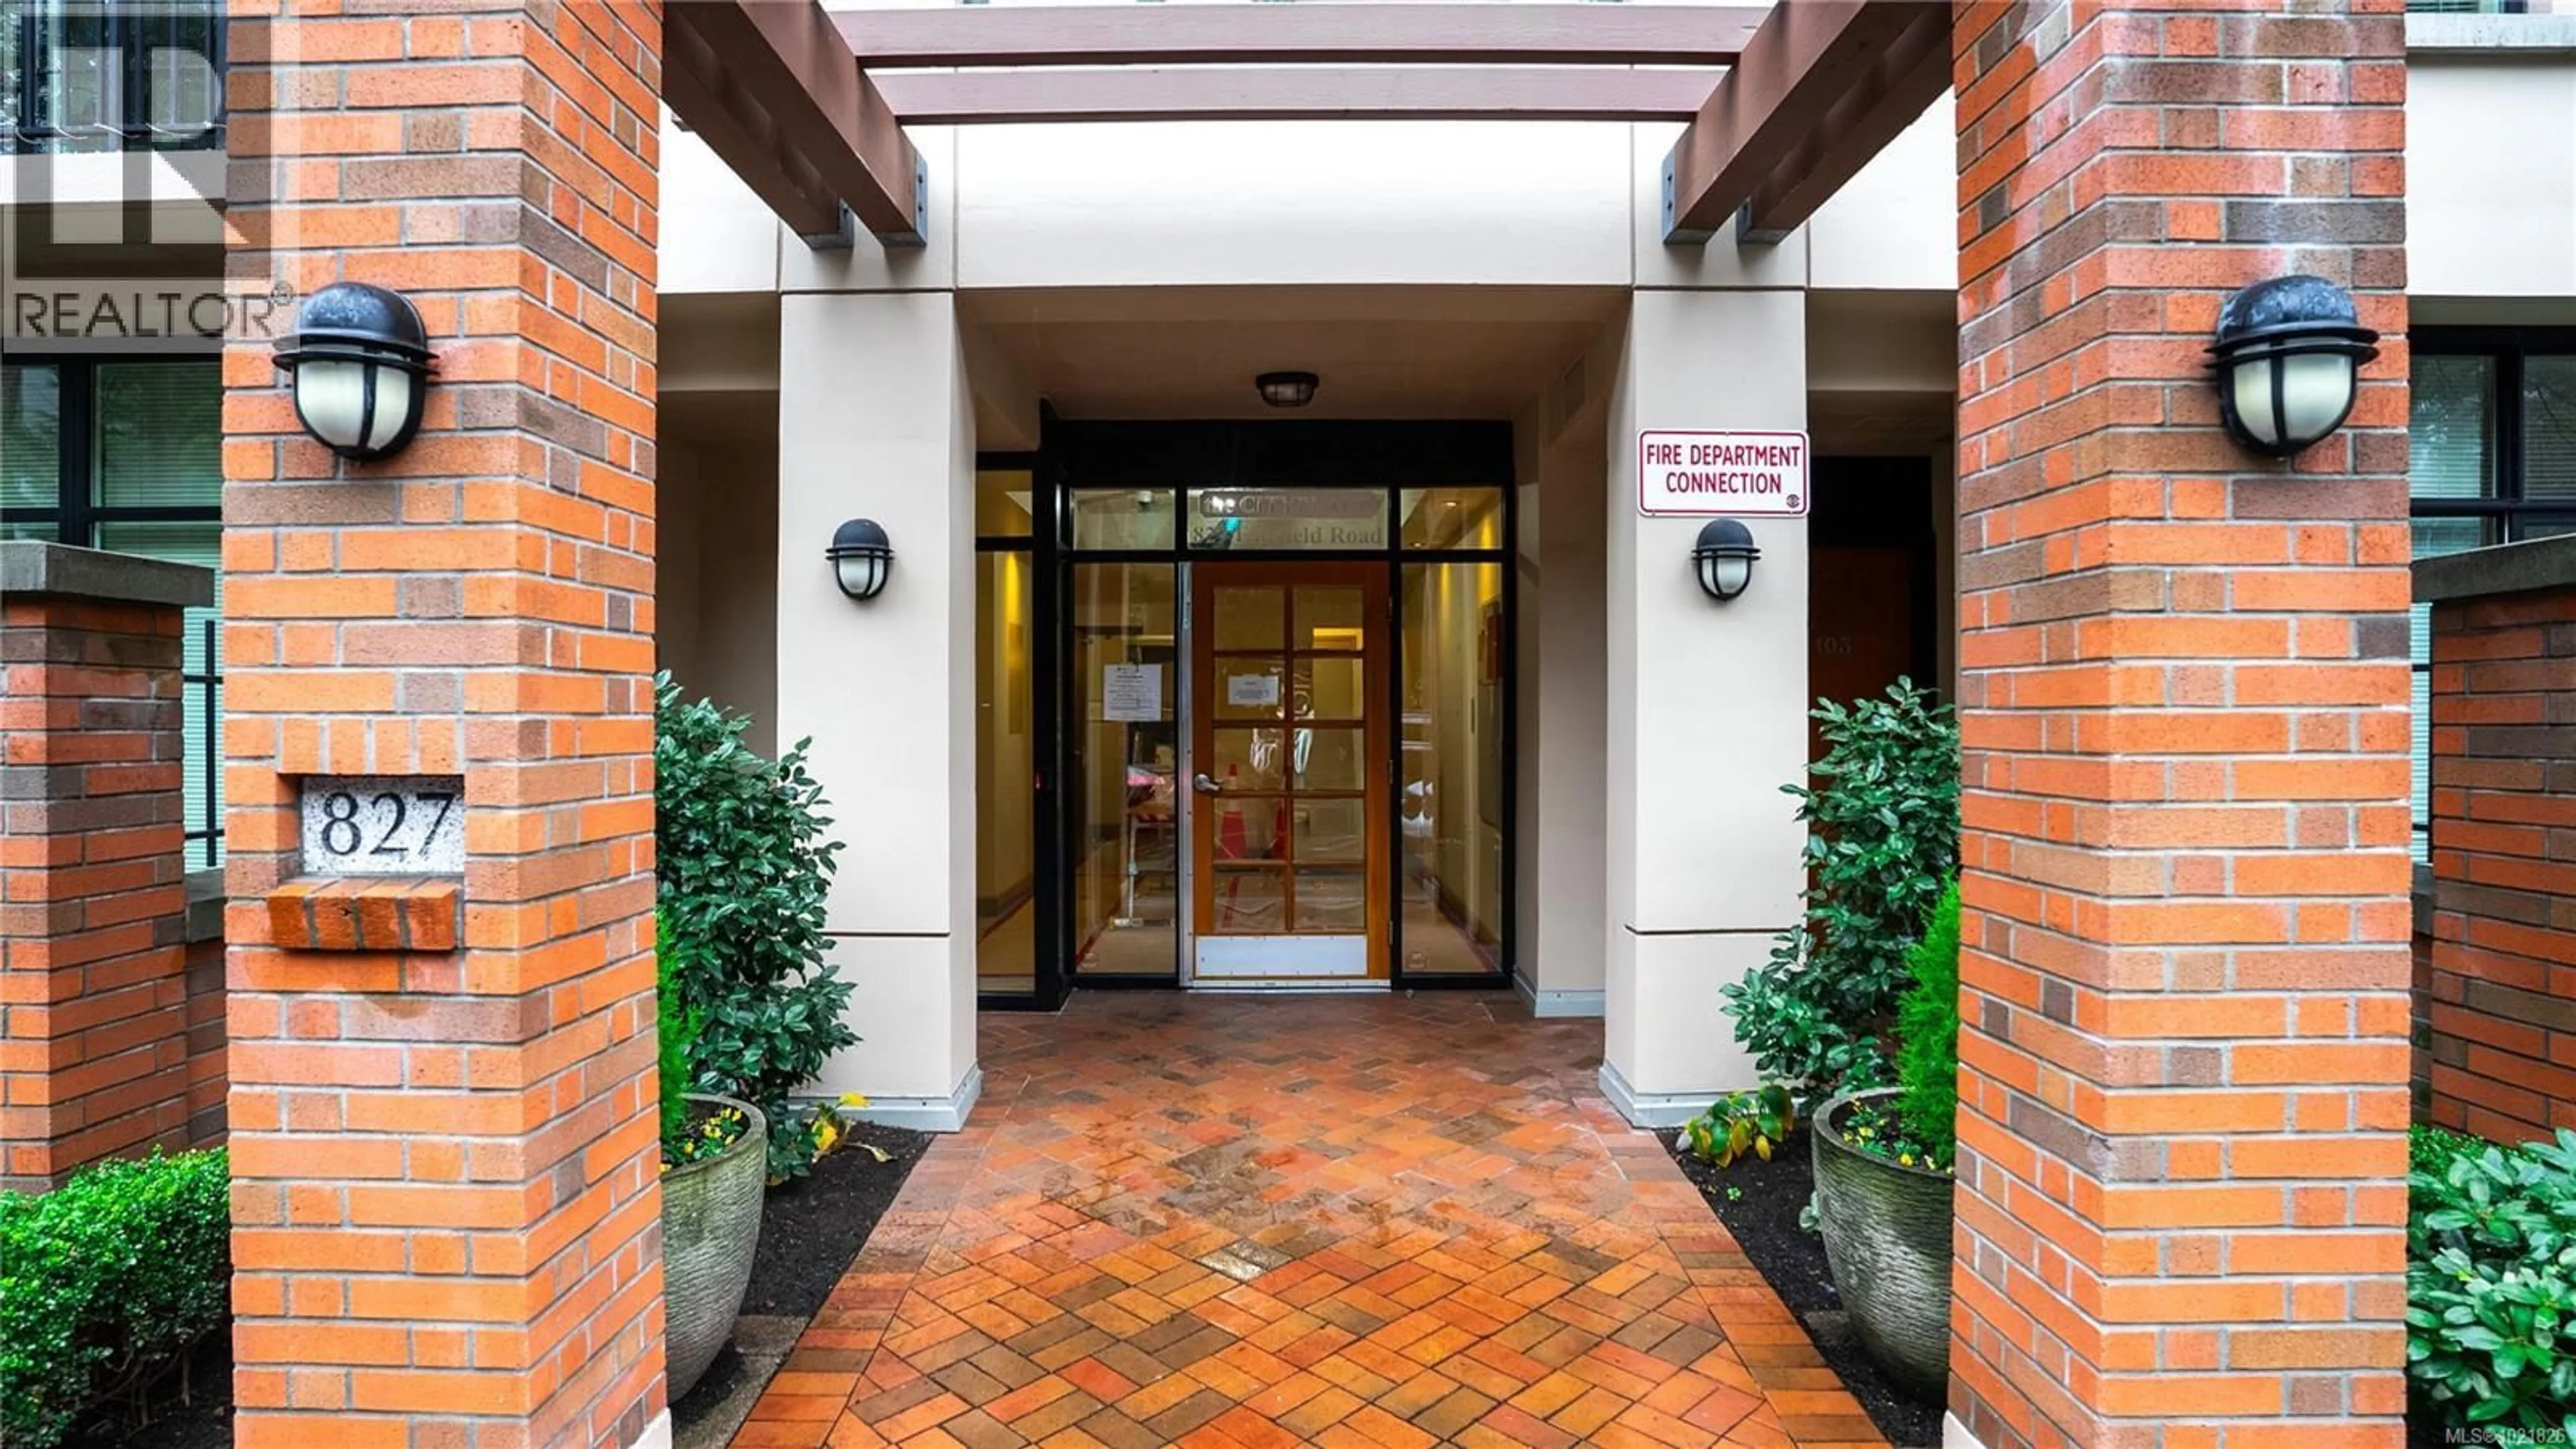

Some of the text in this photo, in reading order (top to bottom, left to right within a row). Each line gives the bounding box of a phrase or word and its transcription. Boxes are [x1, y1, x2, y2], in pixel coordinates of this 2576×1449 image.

[1646, 444, 1800, 466] FIRE DEPARTMENT
[1666, 472, 1782, 494] CONNECTION
[1330, 527, 1382, 544] Road
[321, 792, 455, 859] 827
